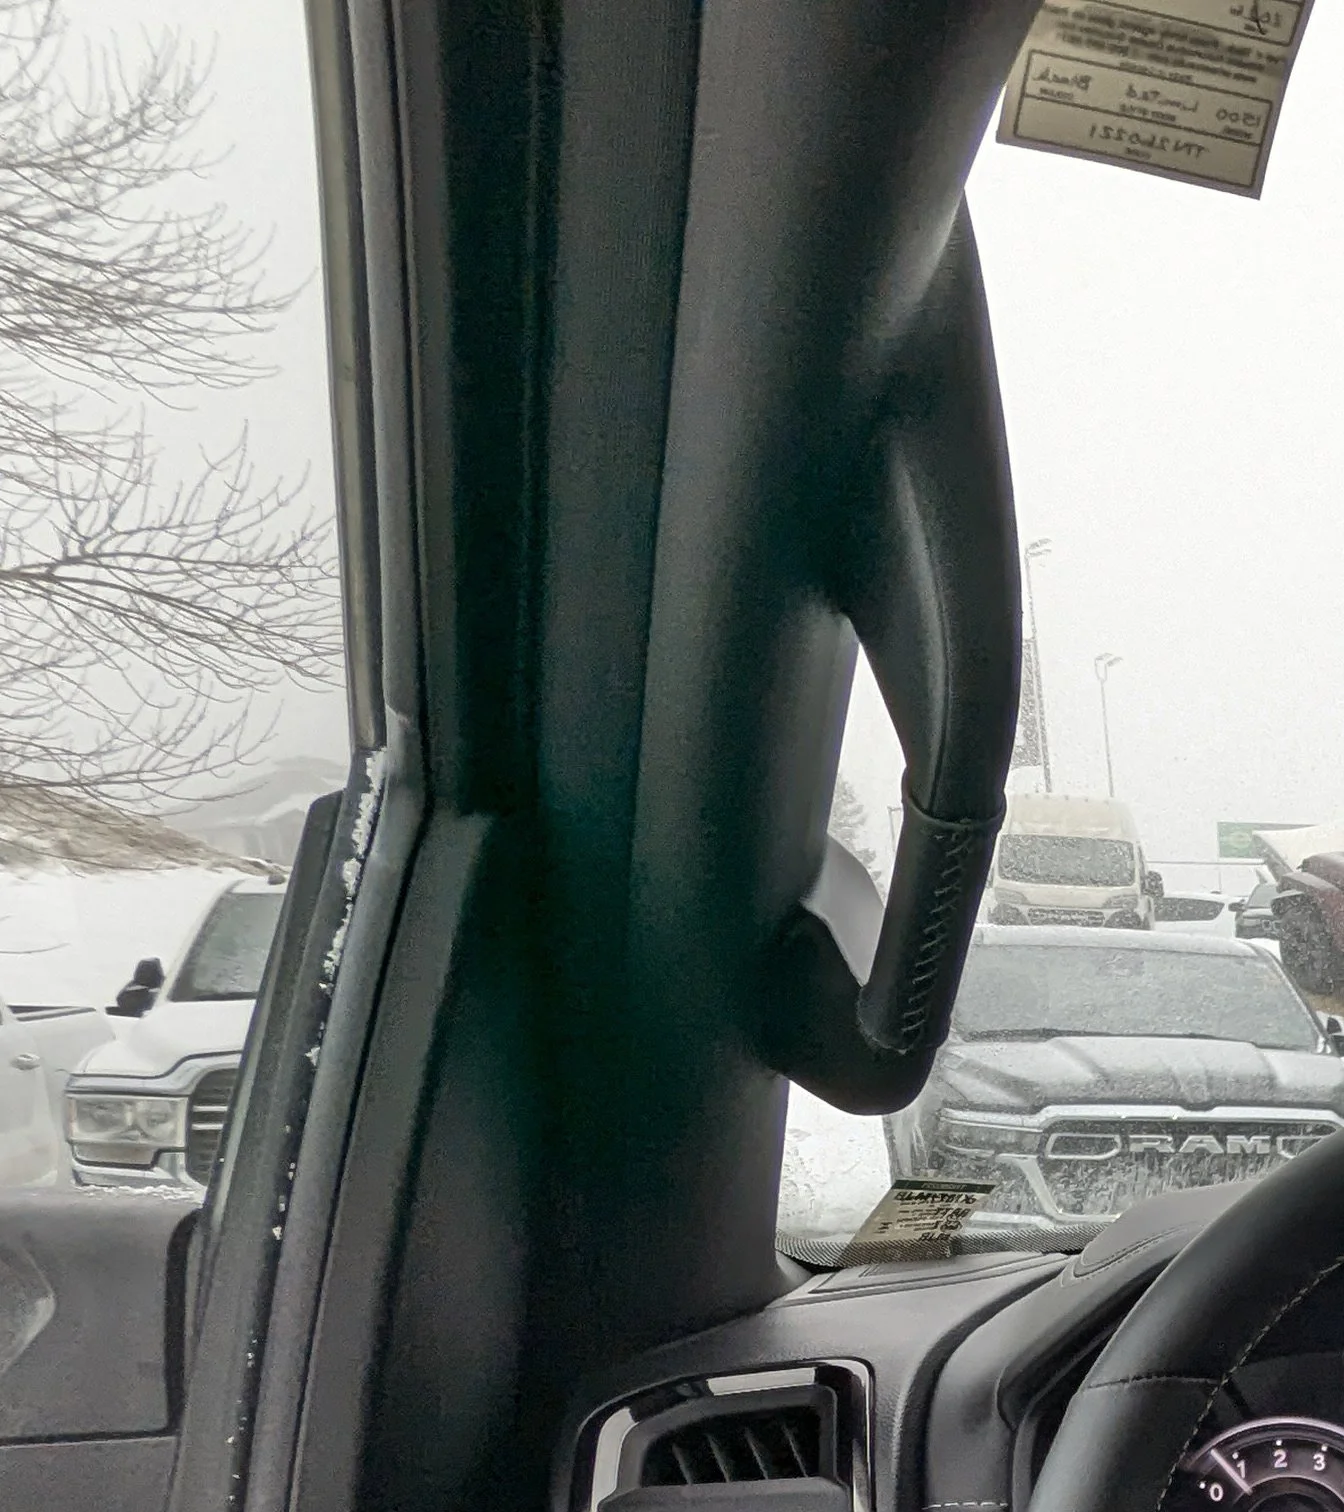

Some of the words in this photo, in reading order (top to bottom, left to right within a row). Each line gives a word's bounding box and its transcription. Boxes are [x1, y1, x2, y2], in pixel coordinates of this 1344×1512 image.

[1129, 1135, 1271, 1155] RAM
[1273, 1449, 1288, 1468] 2
[1312, 1453, 1326, 1472] 3
[1236, 1460, 1247, 1478] 1
[1208, 1484, 1224, 1502] 0
